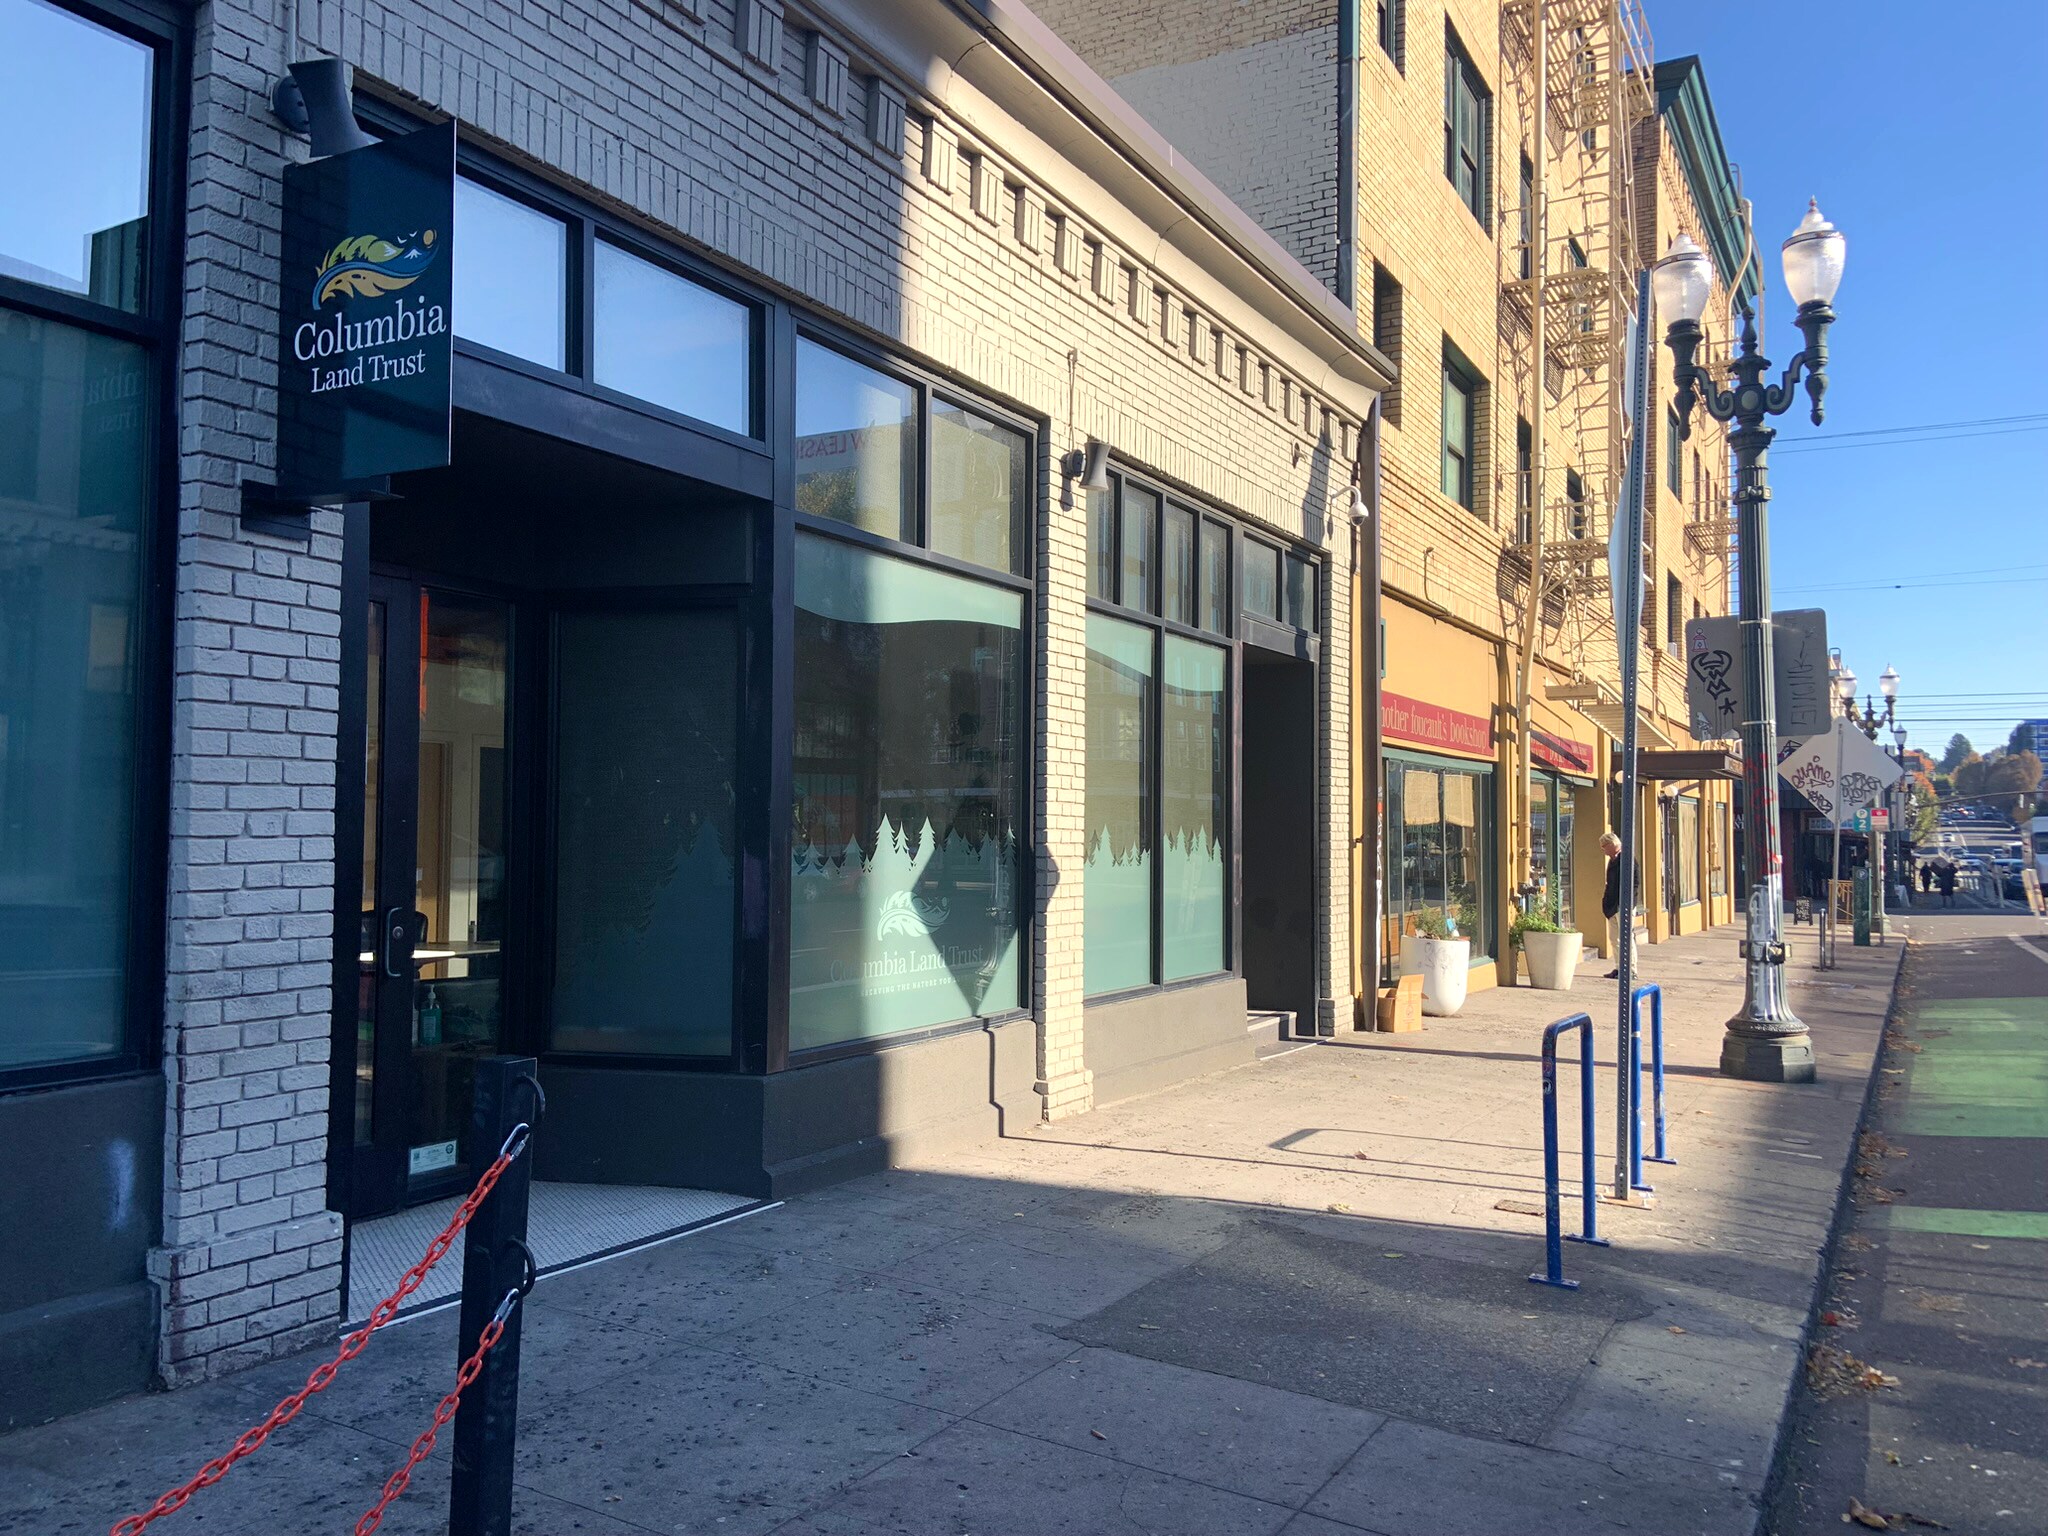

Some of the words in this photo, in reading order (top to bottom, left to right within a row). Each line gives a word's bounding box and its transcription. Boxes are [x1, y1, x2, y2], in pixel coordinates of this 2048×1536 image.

[294, 295, 447, 361] Columbia
[311, 356, 364, 393] Land
[368, 349, 426, 382] Trust
[1410, 705, 1447, 741] foucault's
[1449, 713, 1486, 752] bookshop
[910, 945, 946, 973] Land
